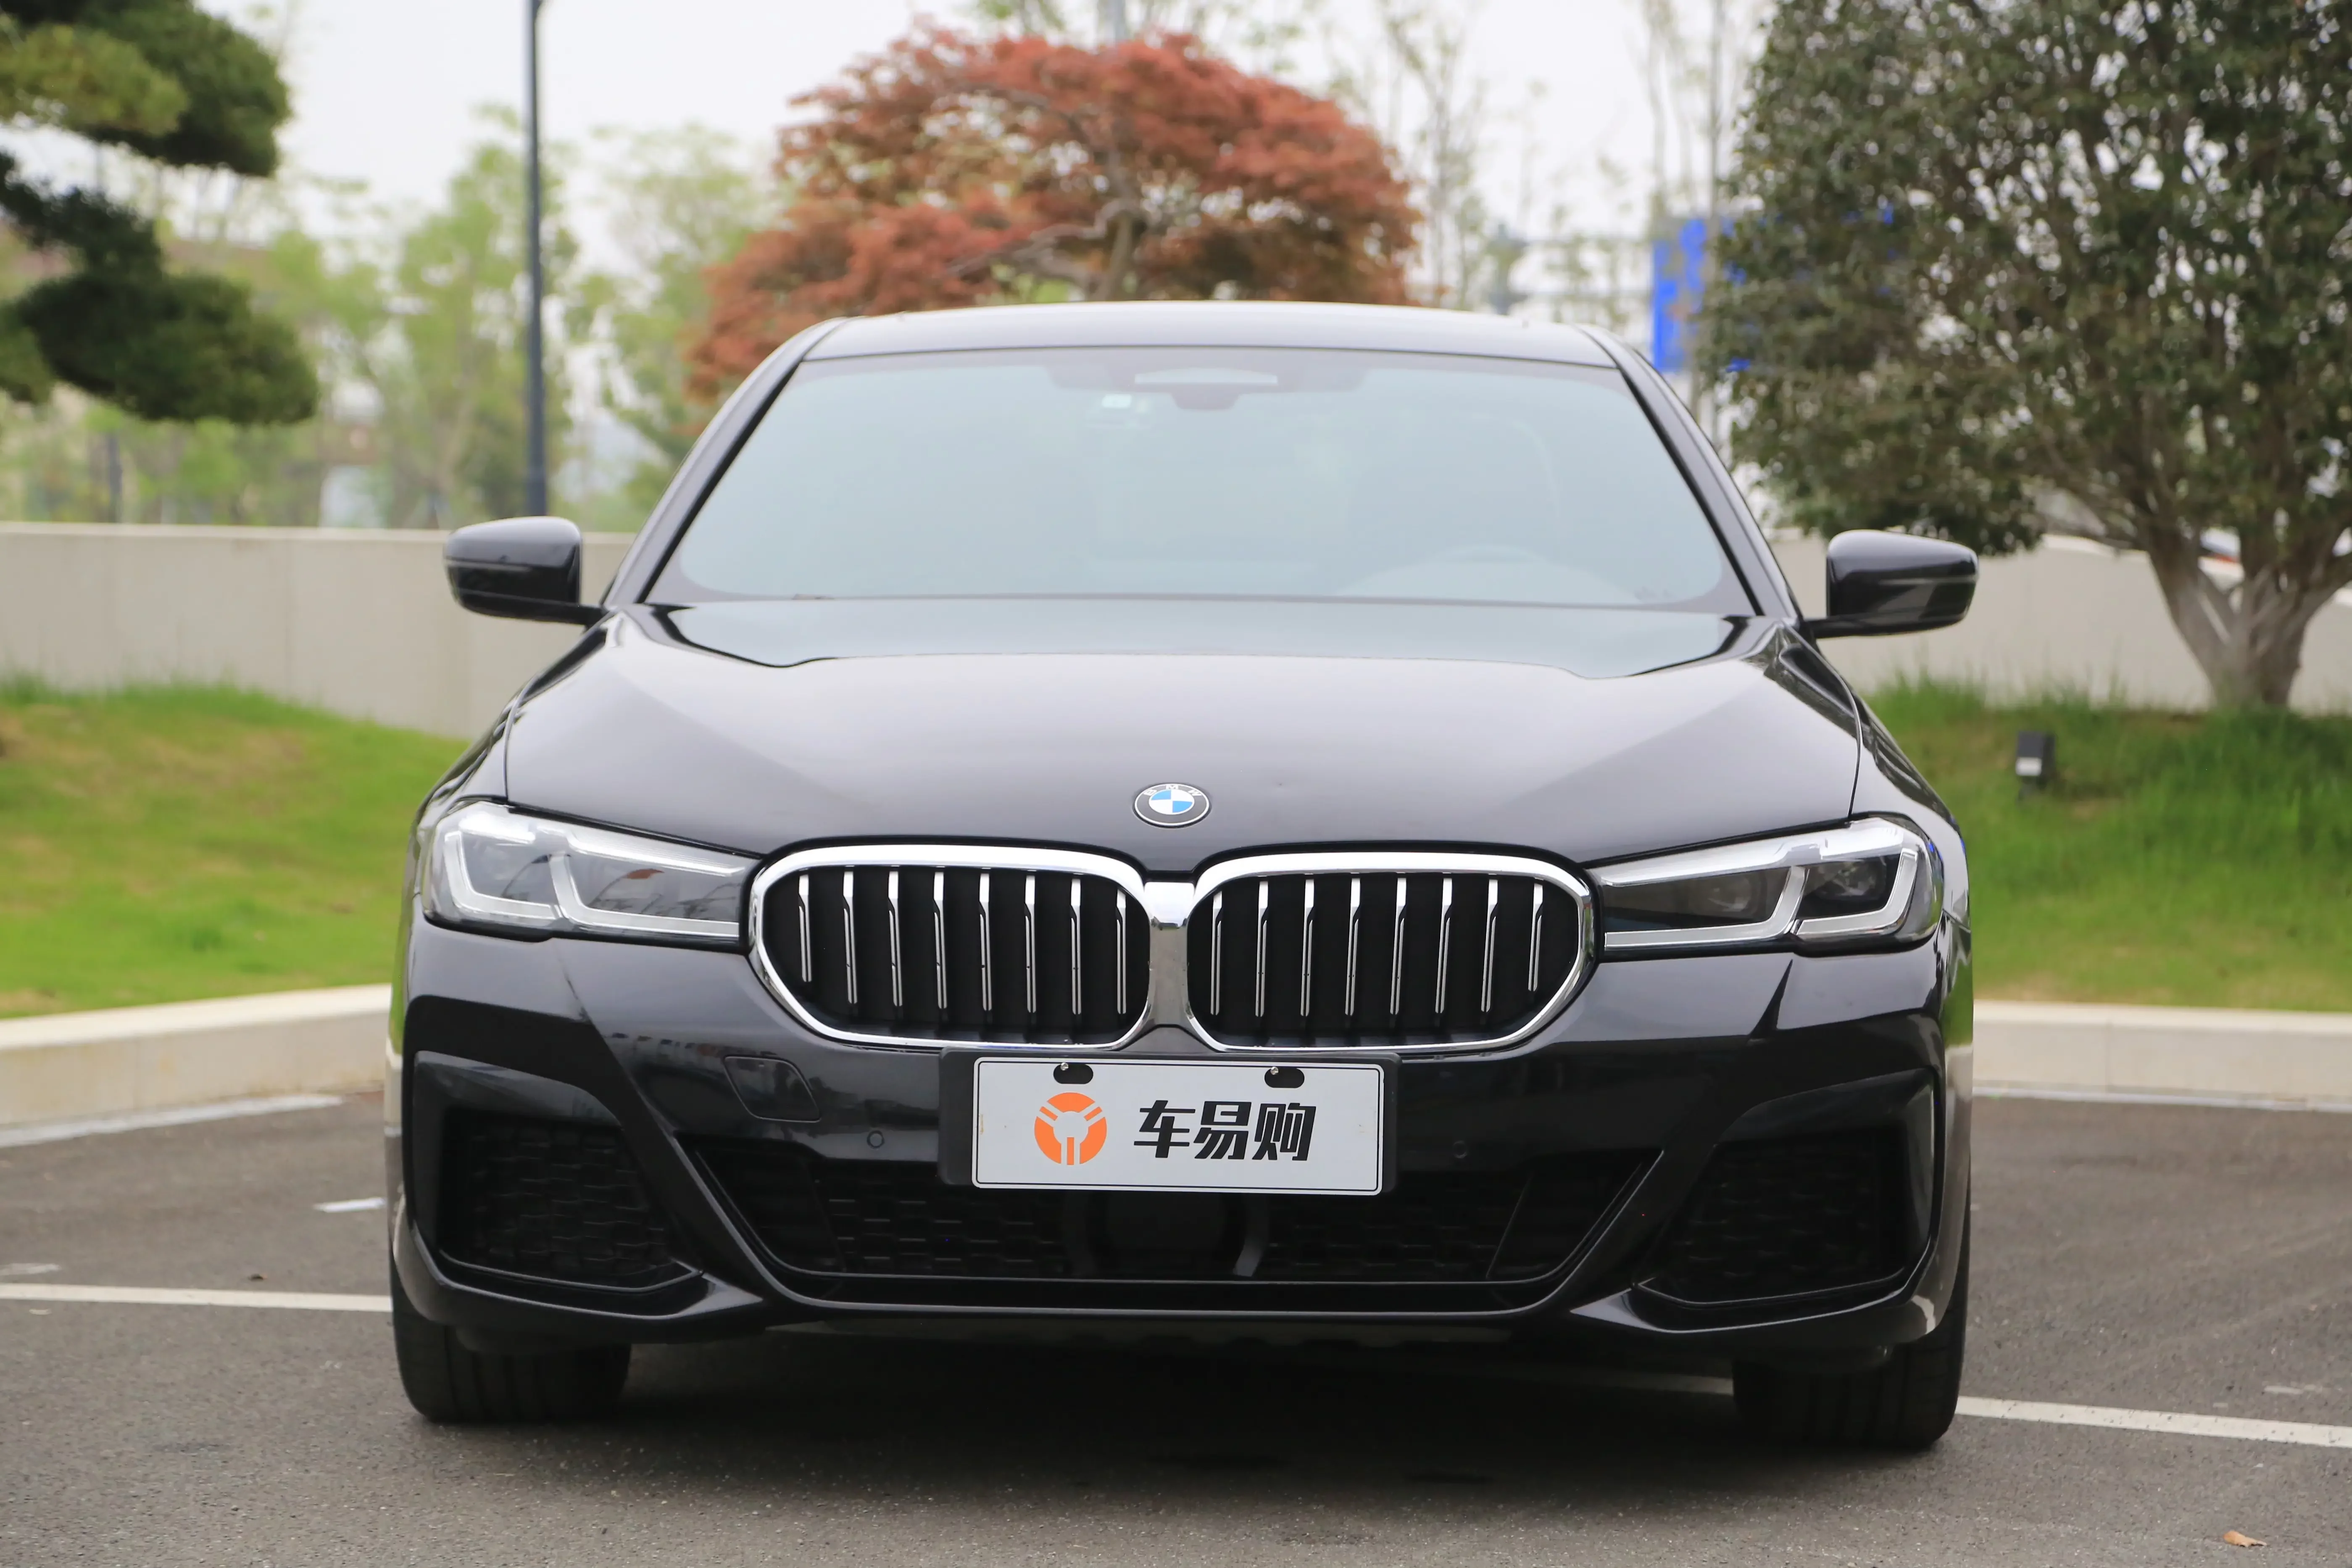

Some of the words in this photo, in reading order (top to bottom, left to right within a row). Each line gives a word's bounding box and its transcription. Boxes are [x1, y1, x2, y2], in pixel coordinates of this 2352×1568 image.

[1142, 785, 1203, 796] BMW
[1134, 1099, 1316, 1161] 车易购
